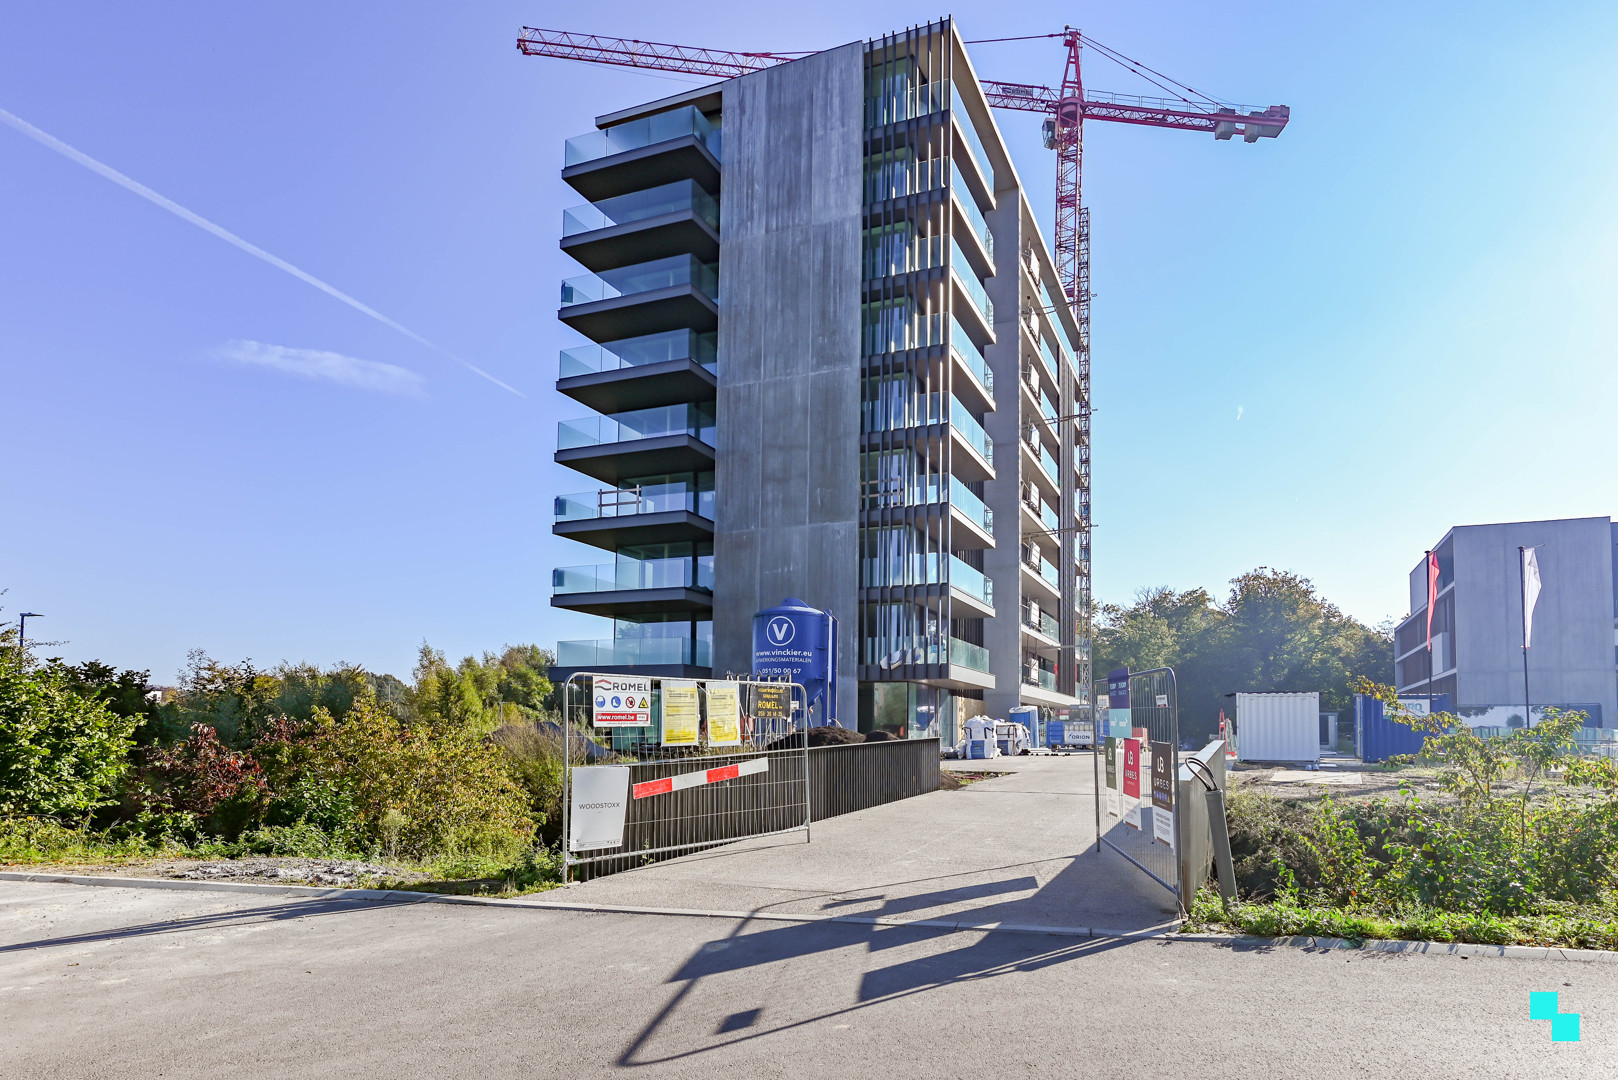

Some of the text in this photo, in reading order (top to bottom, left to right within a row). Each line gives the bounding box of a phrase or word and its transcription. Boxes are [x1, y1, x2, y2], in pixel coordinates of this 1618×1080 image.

[772, 623, 788, 640] V
[755, 648, 812, 656] www.vinckier.eu
[612, 682, 649, 691] ROMEL
[757, 700, 778, 709] ROMEL
[1125, 769, 1138, 780] URBES
[1153, 777, 1170, 790] URBES
